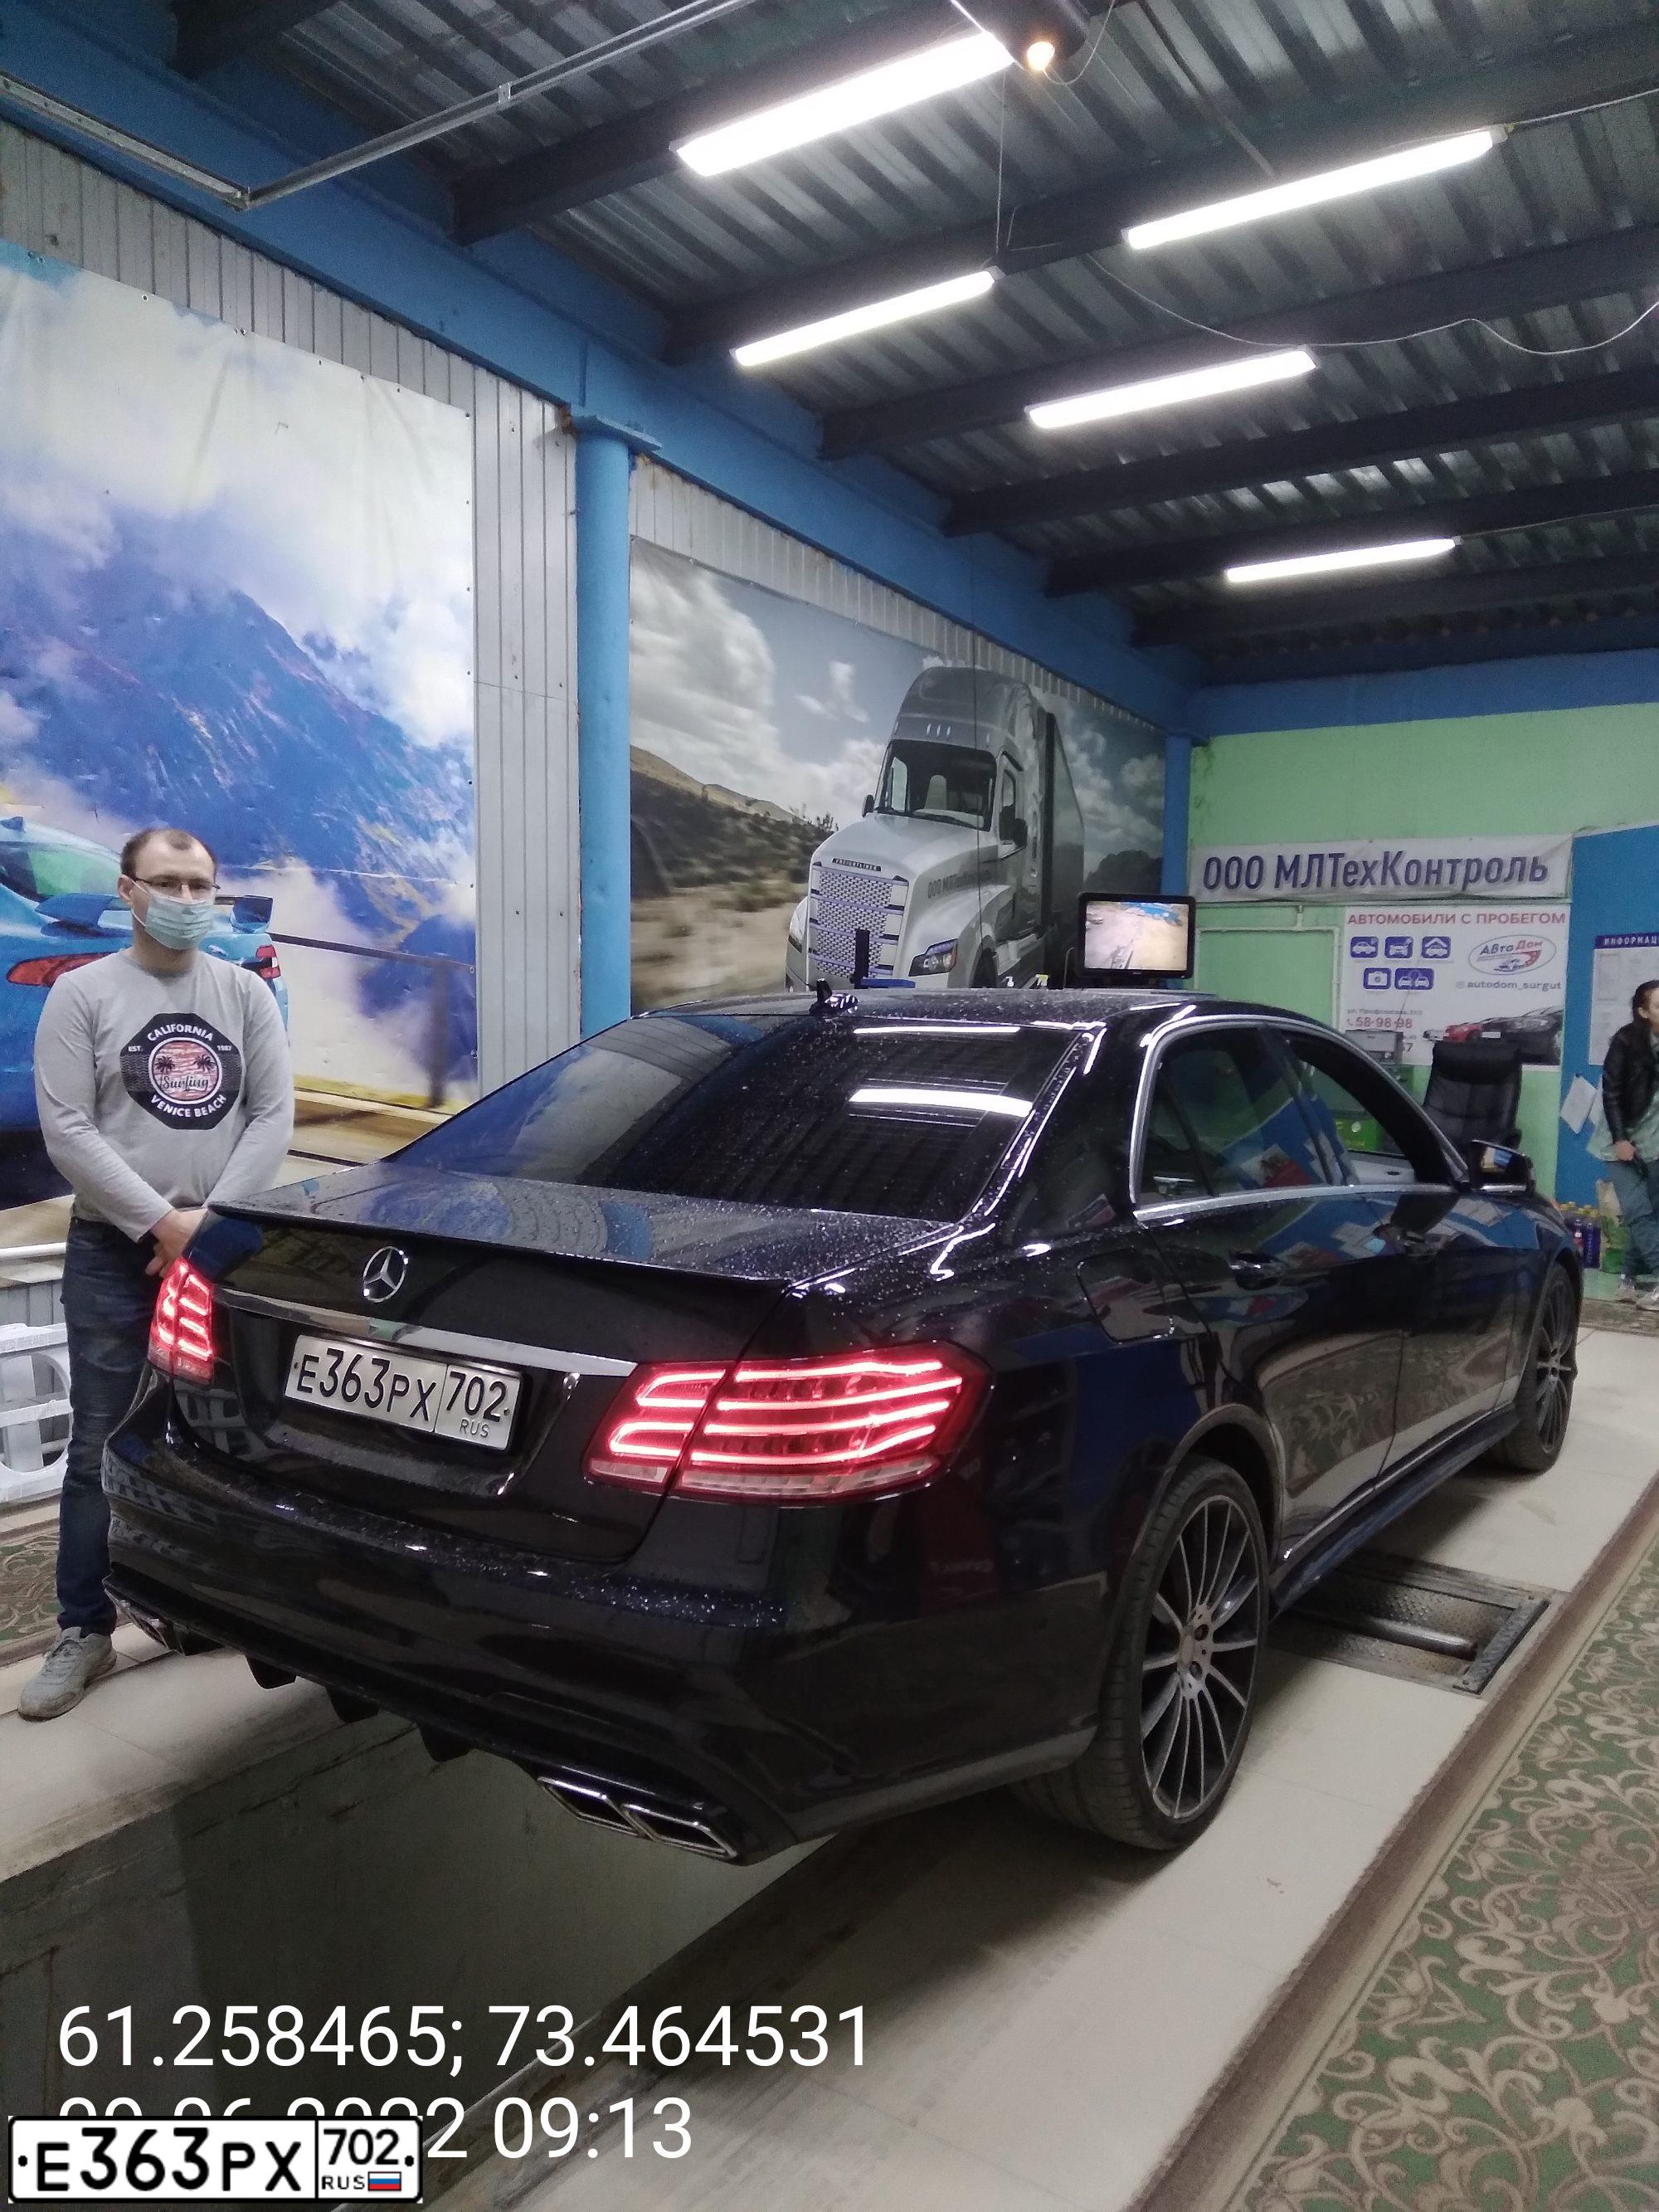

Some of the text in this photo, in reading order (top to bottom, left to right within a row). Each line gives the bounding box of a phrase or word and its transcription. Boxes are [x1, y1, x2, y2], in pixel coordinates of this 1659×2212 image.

[1203, 850, 1550, 892] ООО МЛТехКонтроль
[1347, 913, 1566, 925] АВТОМОБИЛИ С ПРОБЕГОМ
[1603, 934, 1659, 945] ИНФОРМАЦ
[147, 1023, 215, 1041] CALIFORNIA
[162, 1075, 209, 1092] Surfing
[149, 1094, 227, 1118] VENICE BEACH
[445, 1371, 508, 1423] 702
[458, 1418, 490, 1439] RUS
